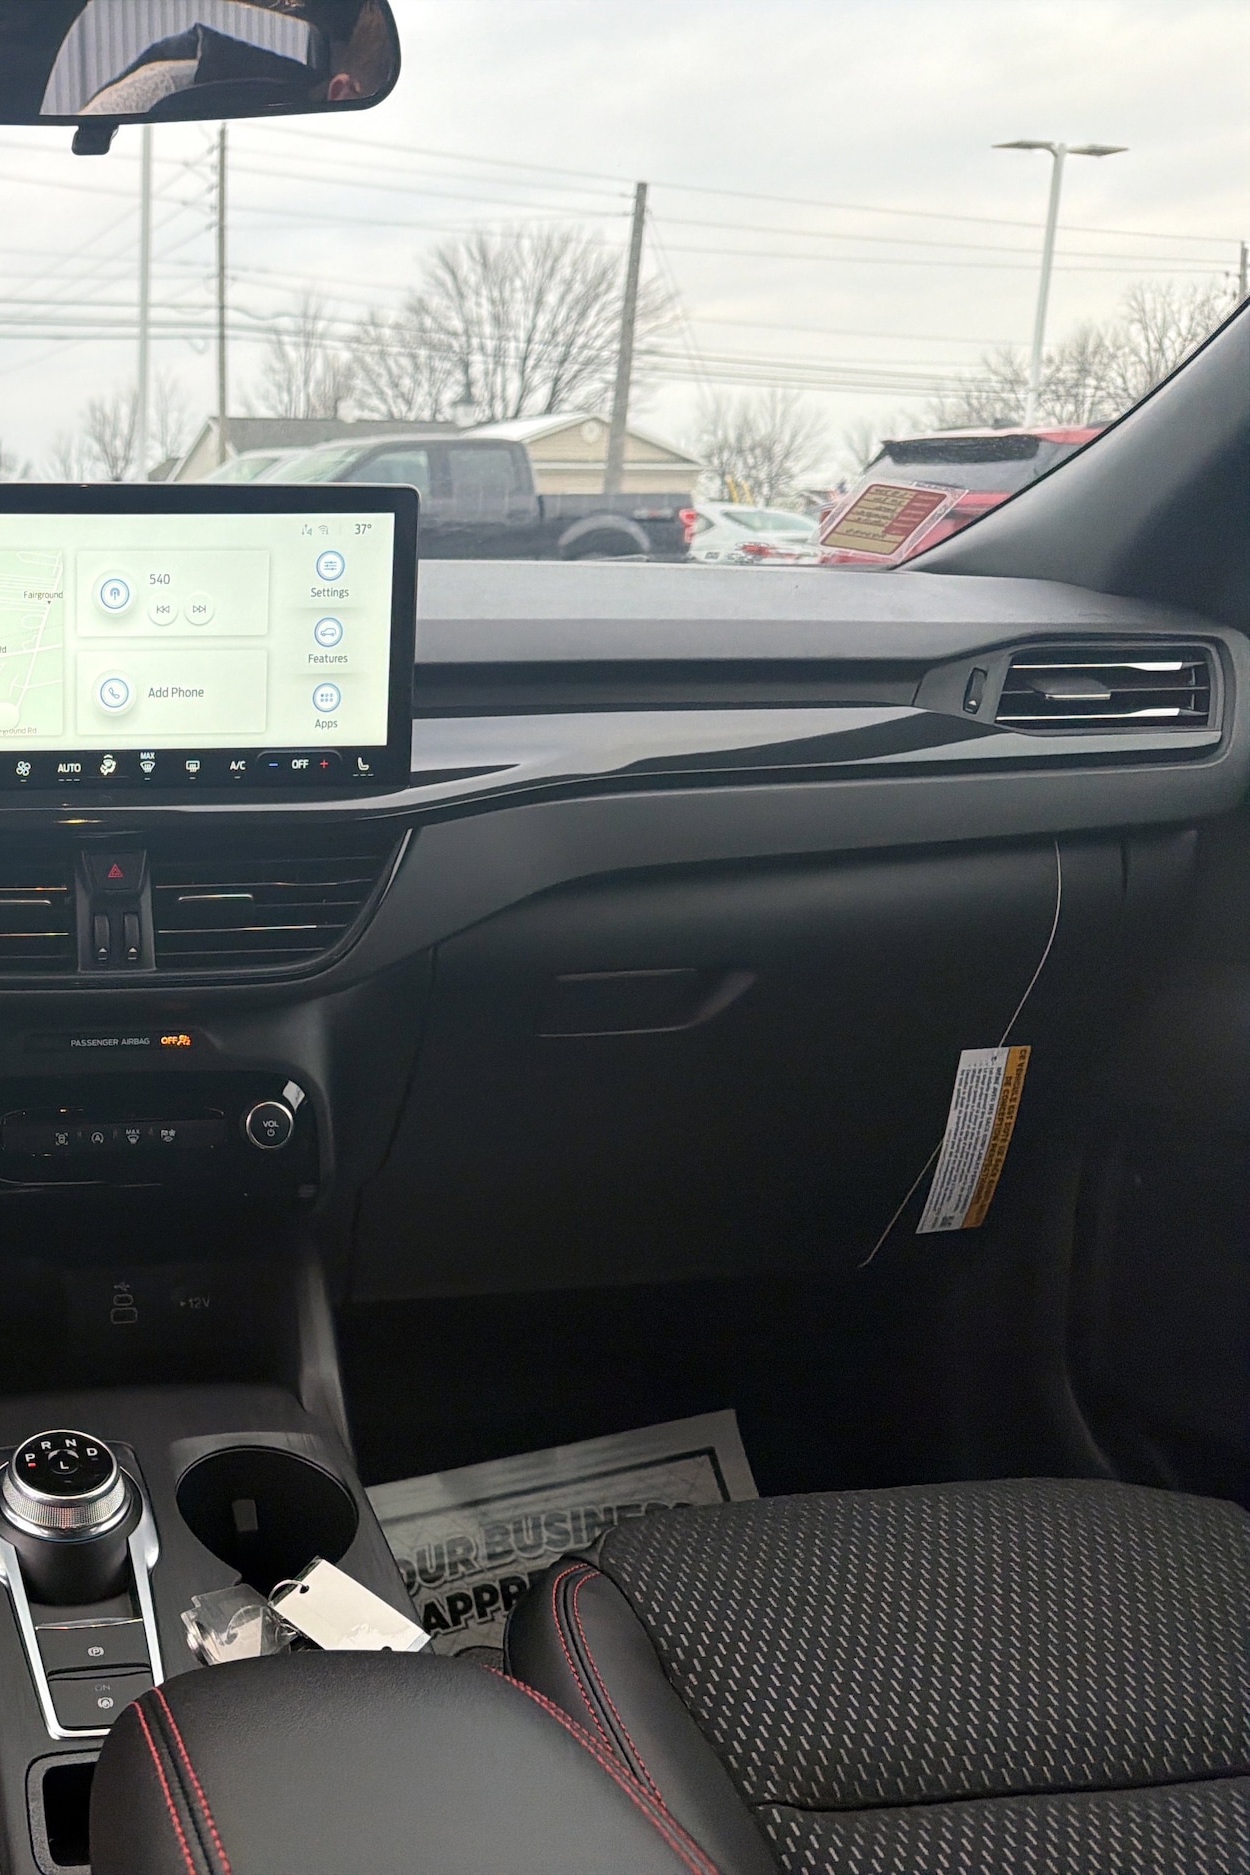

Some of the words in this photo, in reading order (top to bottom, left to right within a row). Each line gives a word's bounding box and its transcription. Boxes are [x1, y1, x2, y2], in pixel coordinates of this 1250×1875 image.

[149, 574, 171, 585] 540
[23, 590, 64, 600] Fairground
[310, 587, 350, 599] Settings
[307, 653, 348, 664] Features
[148, 687, 169, 698] Add
[171, 687, 204, 698] Phone
[314, 718, 338, 730] Apps
[140, 751, 156, 760] MAX
[57, 763, 82, 773] AUTO
[229, 760, 246, 771] A/C
[291, 759, 309, 770] OFF
[70, 1038, 119, 1047] PASSENGER
[120, 1037, 150, 1046] AIRBAG
[160, 1036, 178, 1046] OFF
[262, 1120, 280, 1128] VOL
[40, 1440, 52, 1450] R
[64, 1438, 78, 1448] N
[86, 1447, 98, 1457] D
[24, 1453, 36, 1462] P
[59, 1460, 70, 1470] L
[94, 1683, 111, 1692] ON
